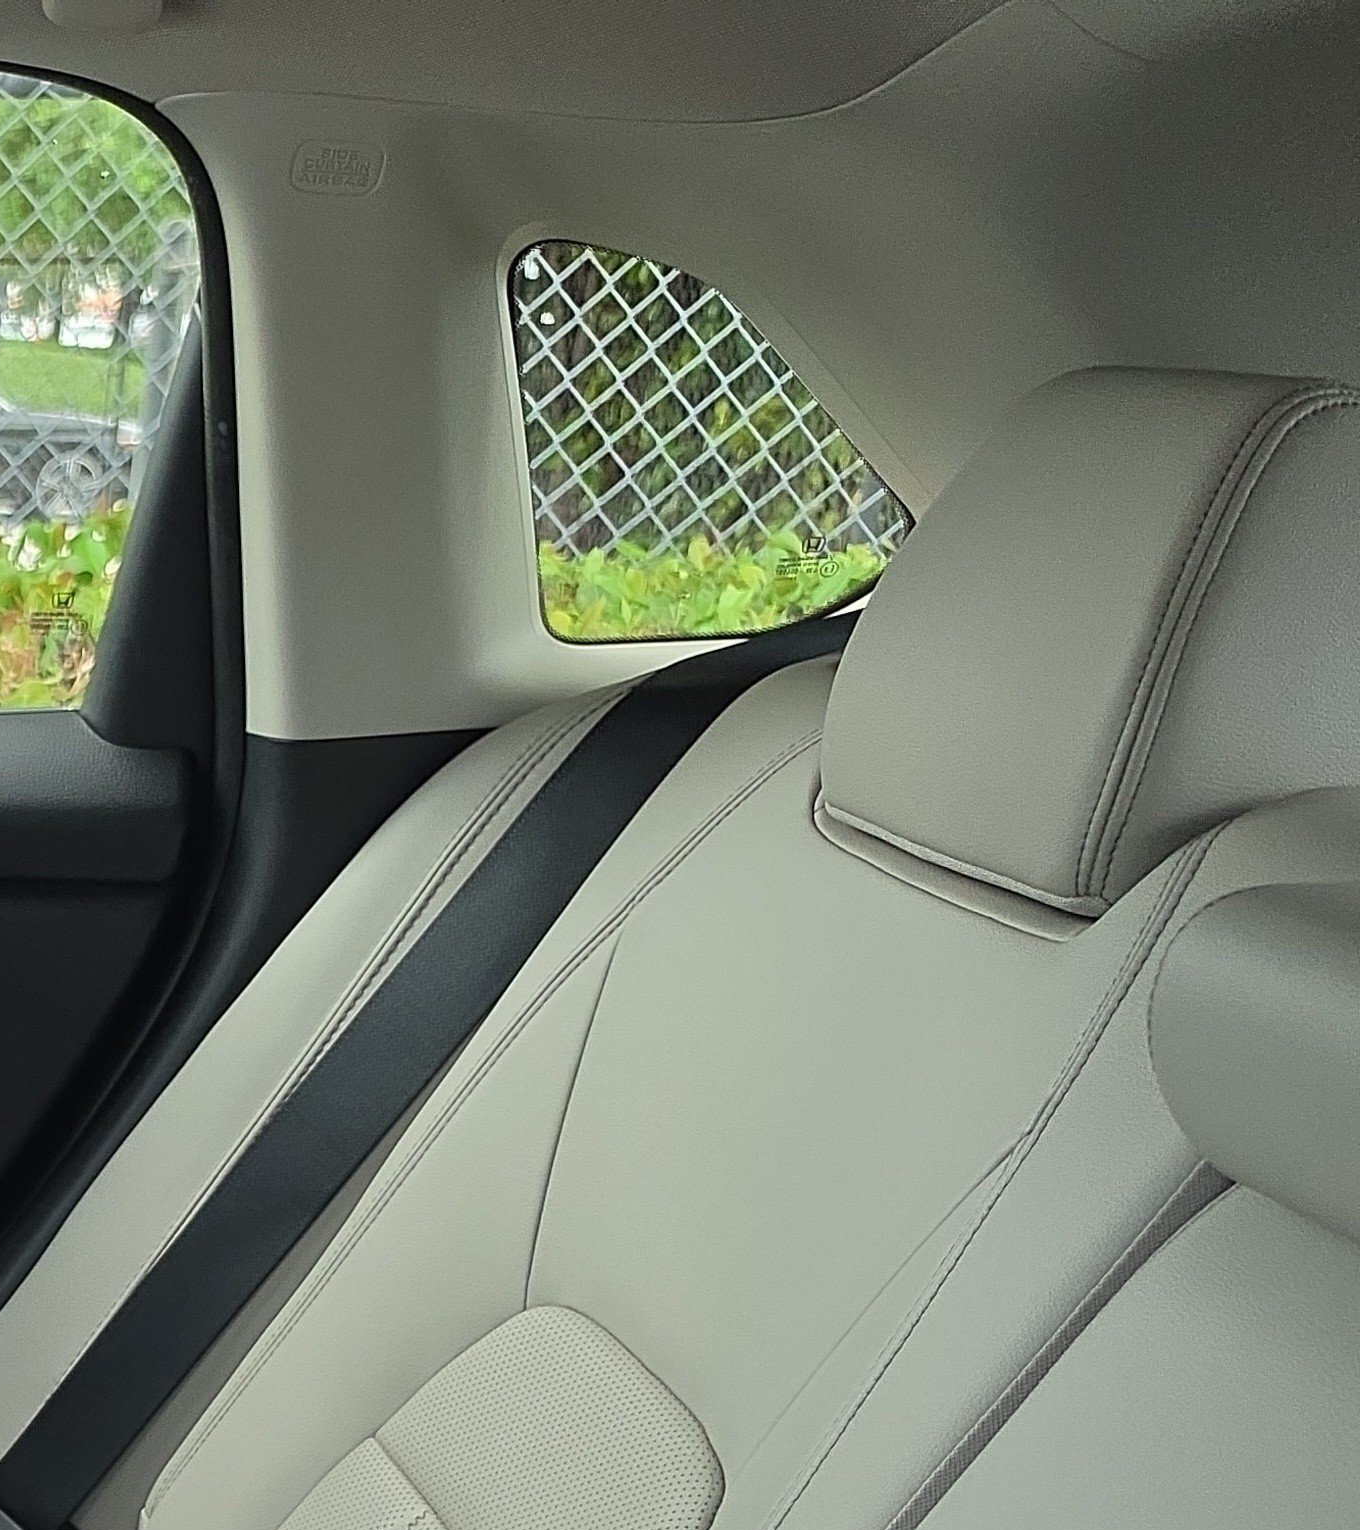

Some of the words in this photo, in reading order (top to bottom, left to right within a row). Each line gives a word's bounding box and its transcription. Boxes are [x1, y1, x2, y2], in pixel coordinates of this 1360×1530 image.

[321, 148, 360, 161] SIDE
[304, 157, 371, 176] CURTAIN
[299, 173, 369, 187] AIRBAG
